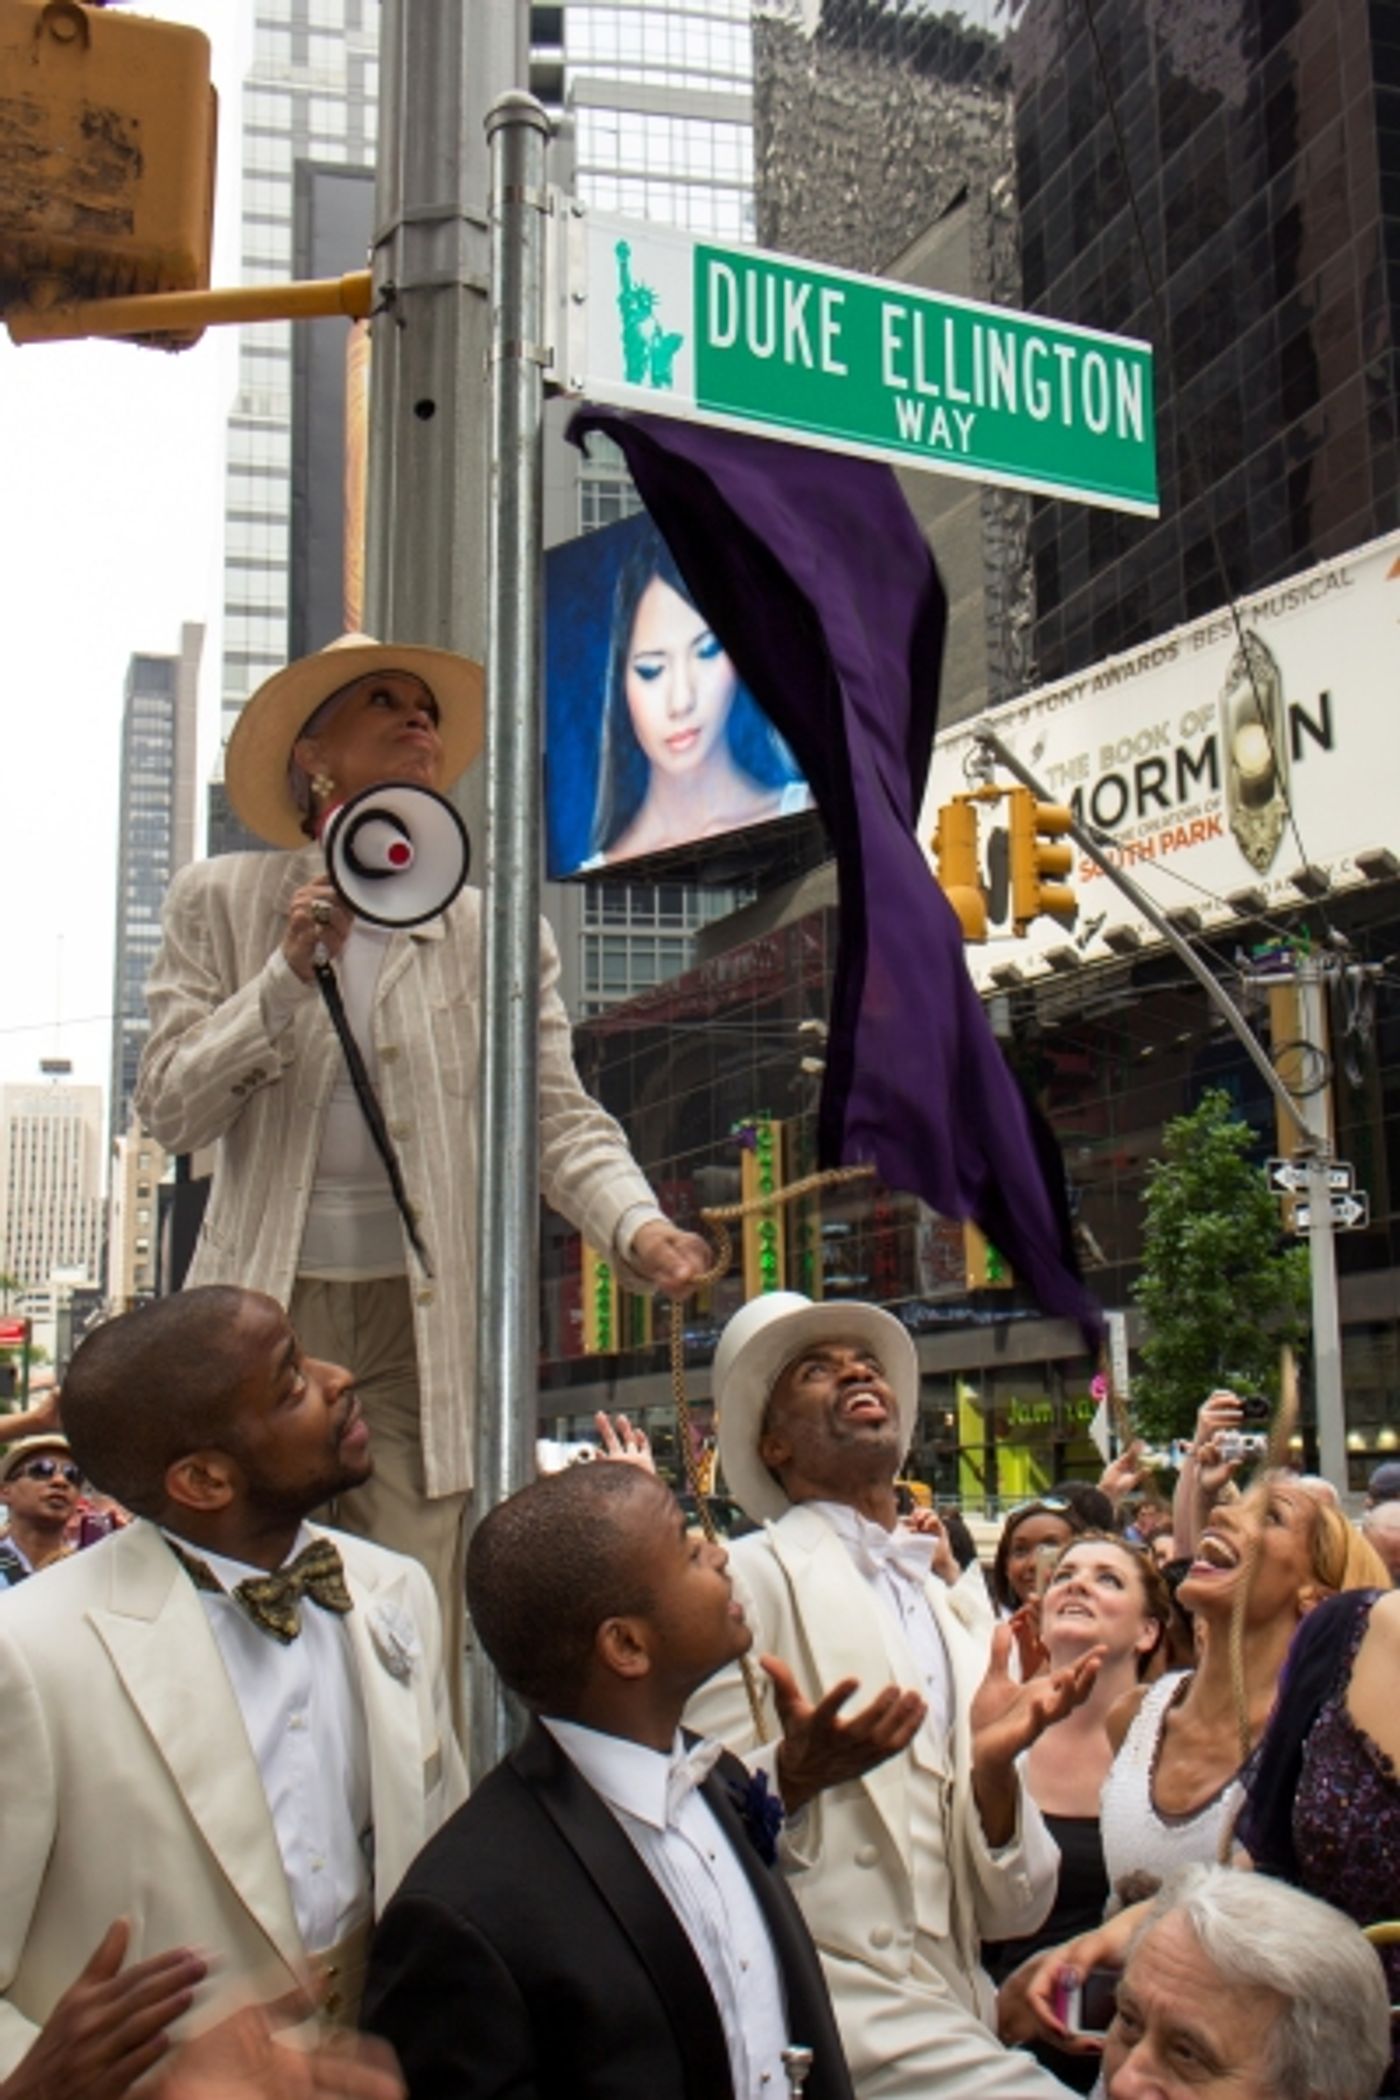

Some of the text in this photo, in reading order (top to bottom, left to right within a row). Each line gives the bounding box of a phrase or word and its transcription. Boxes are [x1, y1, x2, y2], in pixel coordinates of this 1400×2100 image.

[708, 259, 1145, 443] DUKE ELLINGTON
[894, 395, 976, 453] WAY
[1033, 681, 1091, 719] TONY
[1251, 568, 1354, 625] MUSICAL
[1046, 702, 1216, 788] THE BOOK OF
[1159, 812, 1224, 855] PARK
